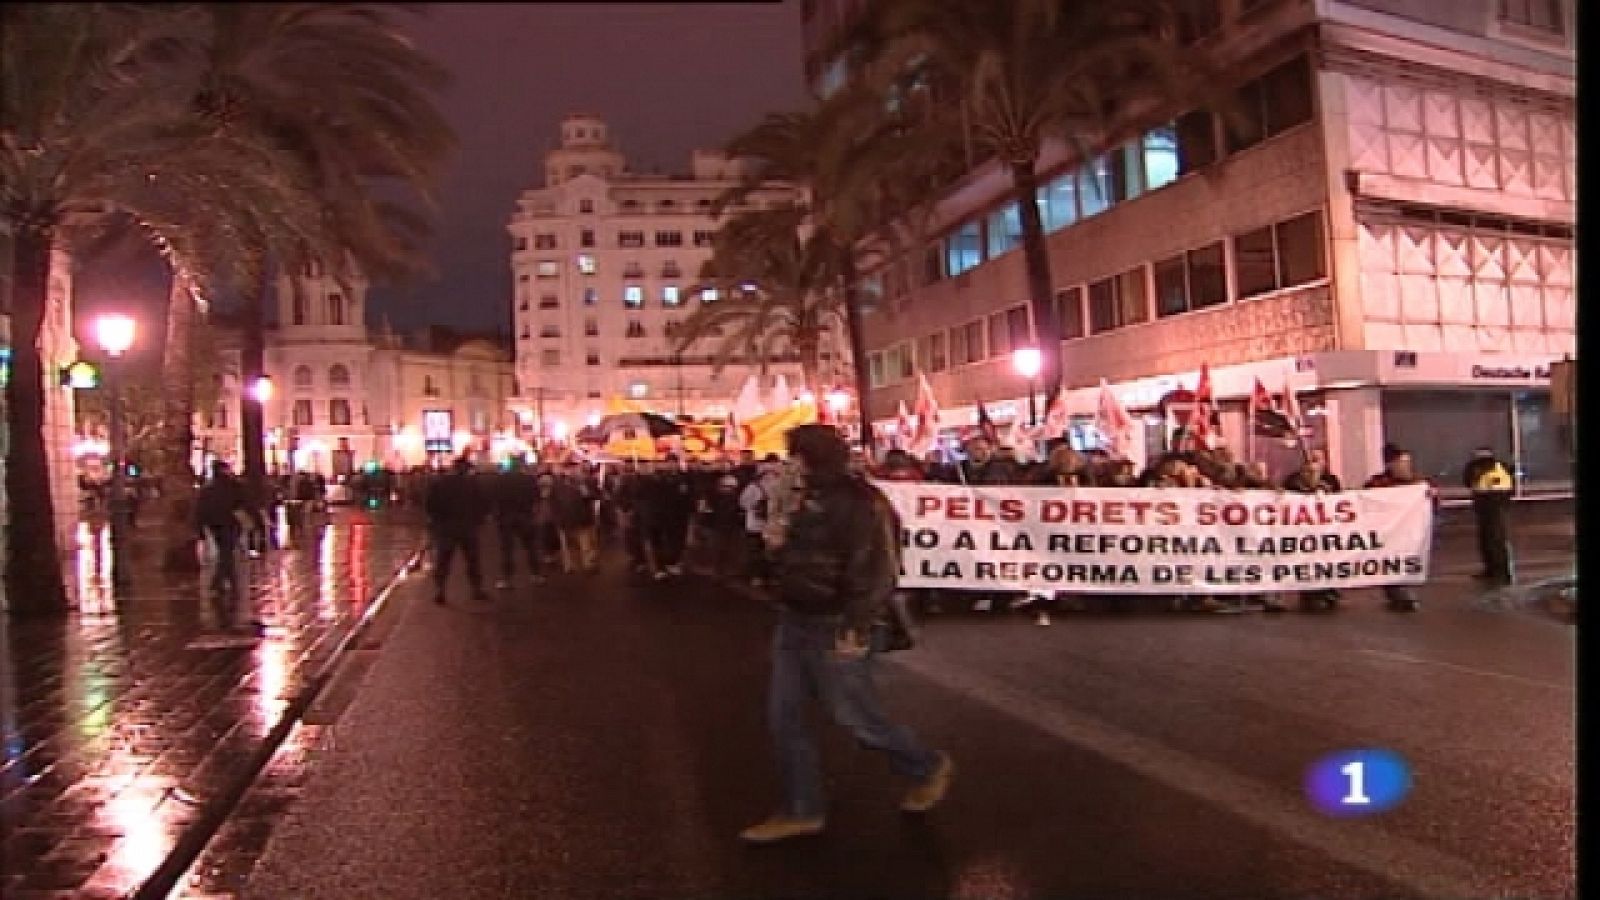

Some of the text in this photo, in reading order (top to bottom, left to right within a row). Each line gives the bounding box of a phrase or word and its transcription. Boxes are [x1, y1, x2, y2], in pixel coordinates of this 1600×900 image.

[916, 497, 1357, 526] PELS DRETS SOCIALS
[953, 530, 977, 550] A
[990, 530, 1034, 551] LA
[1047, 534, 1224, 555] REFORMA
[1235, 530, 1384, 556] LABORAL
[920, 559, 963, 579] LA
[974, 562, 1139, 585] REFORMA
[1151, 564, 1194, 585] DE
[1205, 564, 1262, 584] LES
[1272, 556, 1424, 584] PENSIONS
